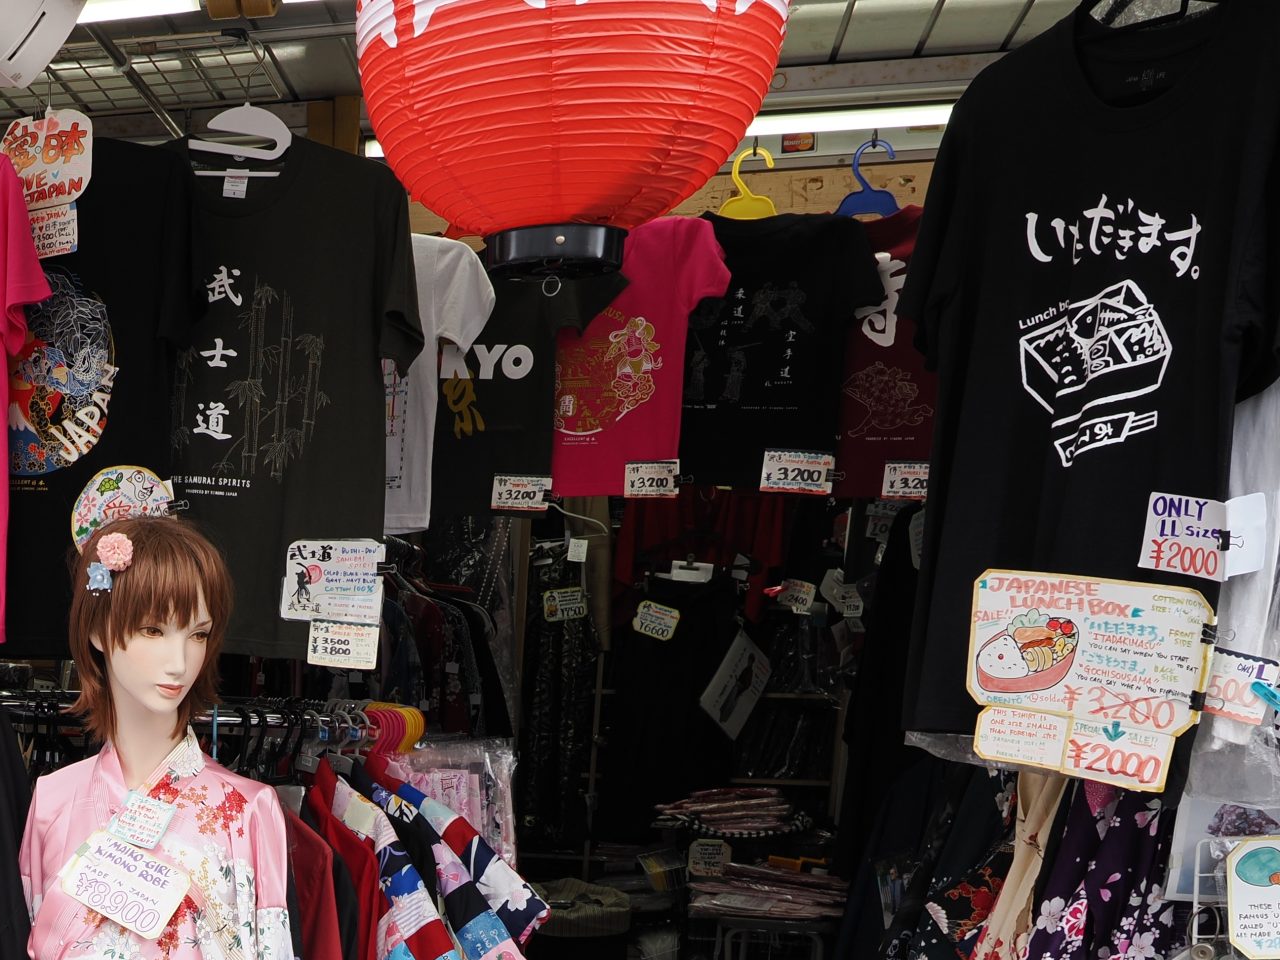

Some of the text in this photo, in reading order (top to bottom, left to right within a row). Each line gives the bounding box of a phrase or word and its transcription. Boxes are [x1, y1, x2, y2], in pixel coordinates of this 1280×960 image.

[42, 122, 87, 164] 日本
[24, 177, 83, 204] JAPAN
[1025, 193, 1201, 279] いただきます。
[1019, 307, 1057, 329] Lunch
[193, 265, 242, 440] 武士道
[780, 330, 796, 377] 空手道
[48, 366, 119, 463] JAPAN
[170, 475, 251, 488] THE SAMURAI SPIRITS
[1152, 496, 1208, 521] ONLY
[1159, 519, 1180, 537] LL
[289, 544, 333, 562] 武士道
[1150, 539, 1218, 575] ¥2000
[353, 585, 375, 593] 100%
[989, 577, 1101, 596] JAPANESE
[287, 600, 322, 614] 武士道
[1009, 595, 1131, 617] LUNCH BOX
[1152, 594, 1184, 605] COTTON
[973, 609, 1014, 623] SALE!!
[1169, 629, 1196, 639] FRONT
[1089, 642, 1102, 650] YOU
[1133, 650, 1153, 658] WHEN
[1170, 655, 1189, 663] START
[1186, 666, 1199, 674] EAT
[1237, 663, 1269, 680] ONLY L
[1075, 672, 1087, 680] YOU
[1106, 678, 1117, 687] SAY
[1120, 682, 1142, 690] WHEN
[1009, 730, 1038, 738] FOREIGN
[1027, 722, 1058, 730] SMALLER
[1074, 722, 1102, 735] SPECIAL
[1067, 739, 1161, 784] ¥2000
[95, 845, 170, 889] KIMONO ROBE
[85, 865, 159, 906] MADE IN JAPAN
